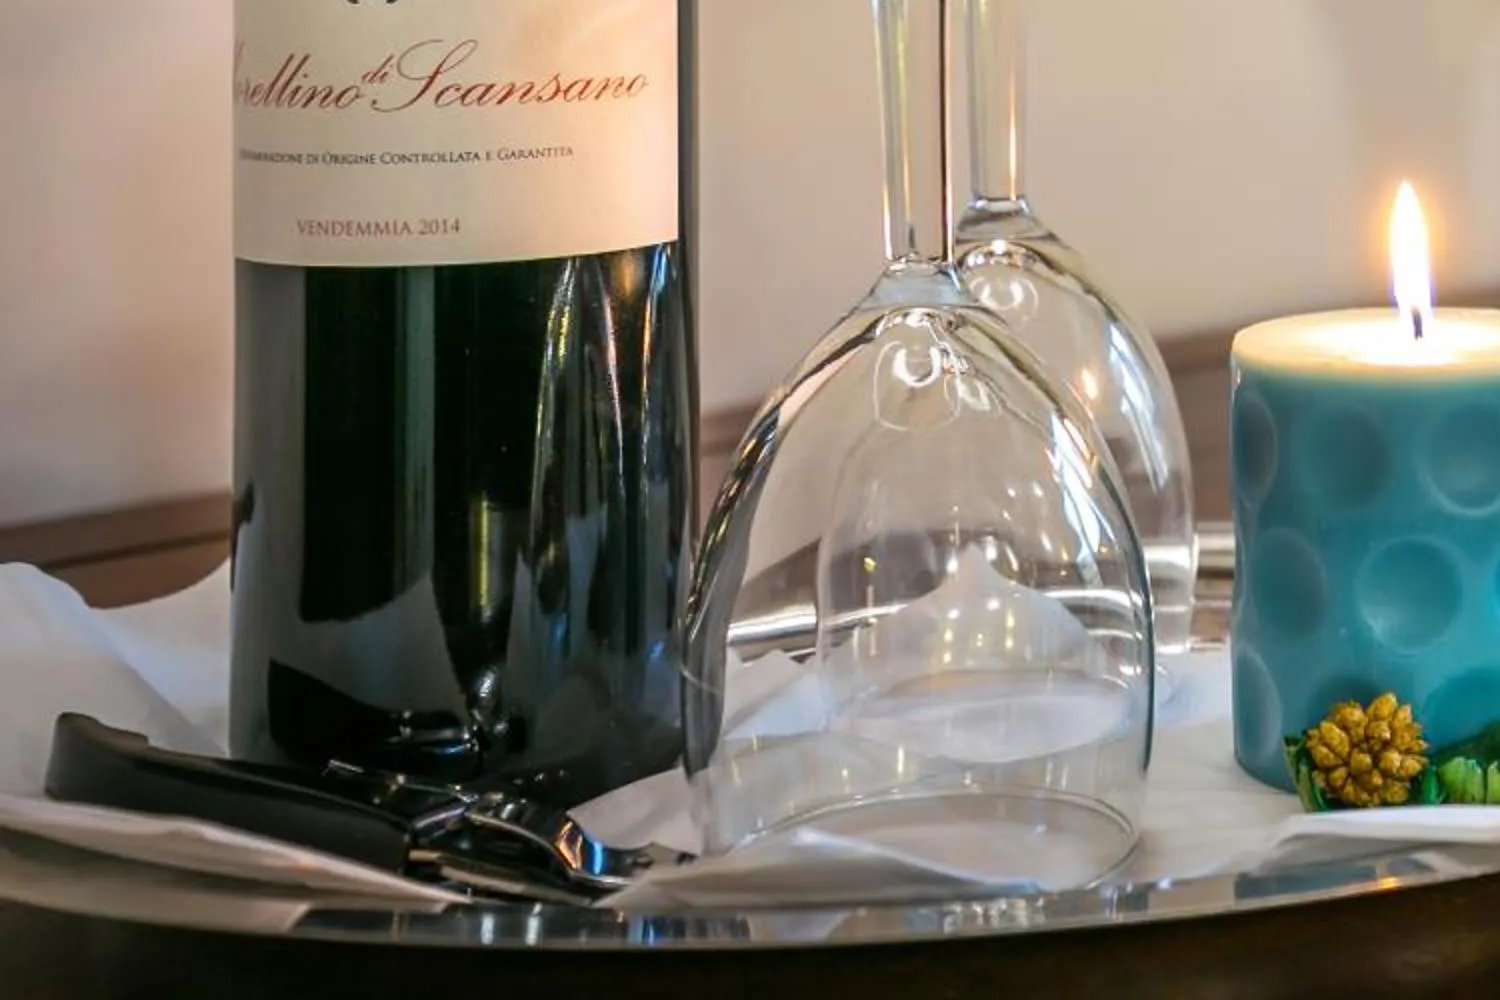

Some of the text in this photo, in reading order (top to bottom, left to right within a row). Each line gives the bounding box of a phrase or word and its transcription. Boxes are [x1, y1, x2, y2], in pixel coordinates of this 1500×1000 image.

[361, 53, 394, 85] di
[370, 38, 648, 114] Scansano
[379, 151, 481, 165] CONTROLLATA
[497, 146, 574, 161] GARANTITA
[297, 217, 461, 238] VENDEMMIA 2014
